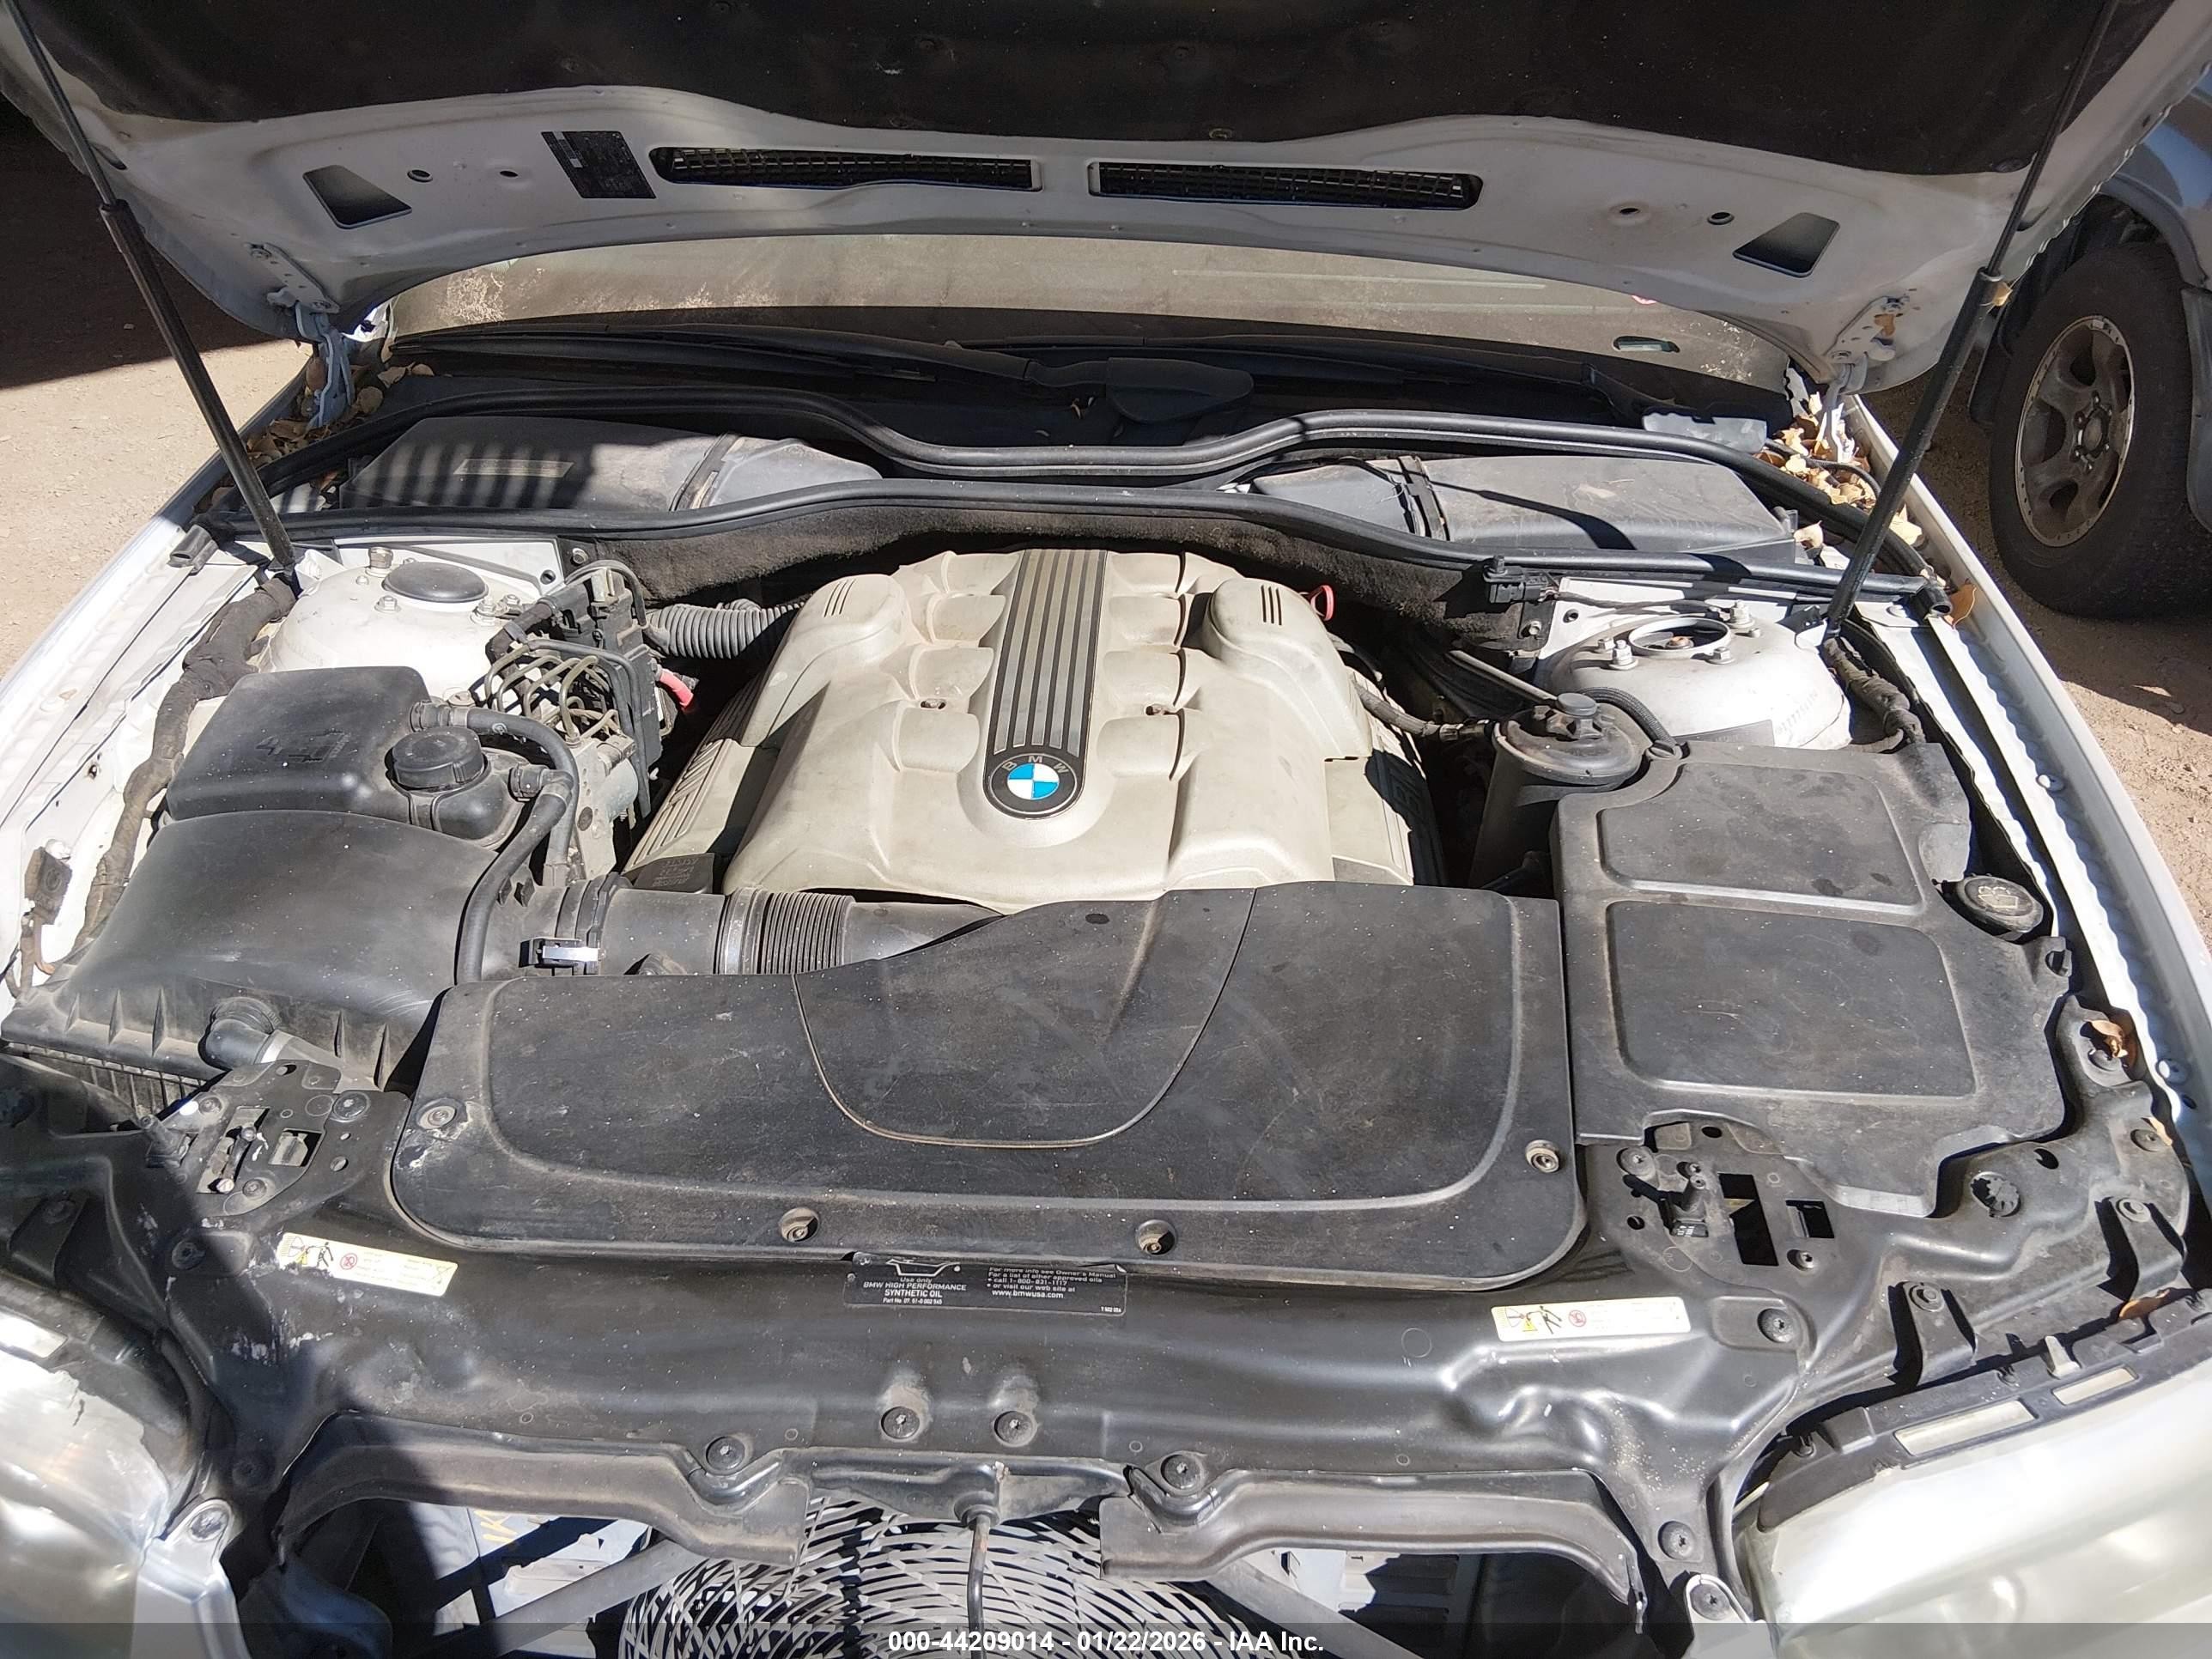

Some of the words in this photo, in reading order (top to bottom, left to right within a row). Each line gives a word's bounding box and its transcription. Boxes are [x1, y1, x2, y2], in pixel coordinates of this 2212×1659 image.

[1001, 755, 1069, 774] BMW
[884, 1289, 928, 1297] SYNTHETIC
[992, 1290, 1064, 1298] www.bmwusa.com
